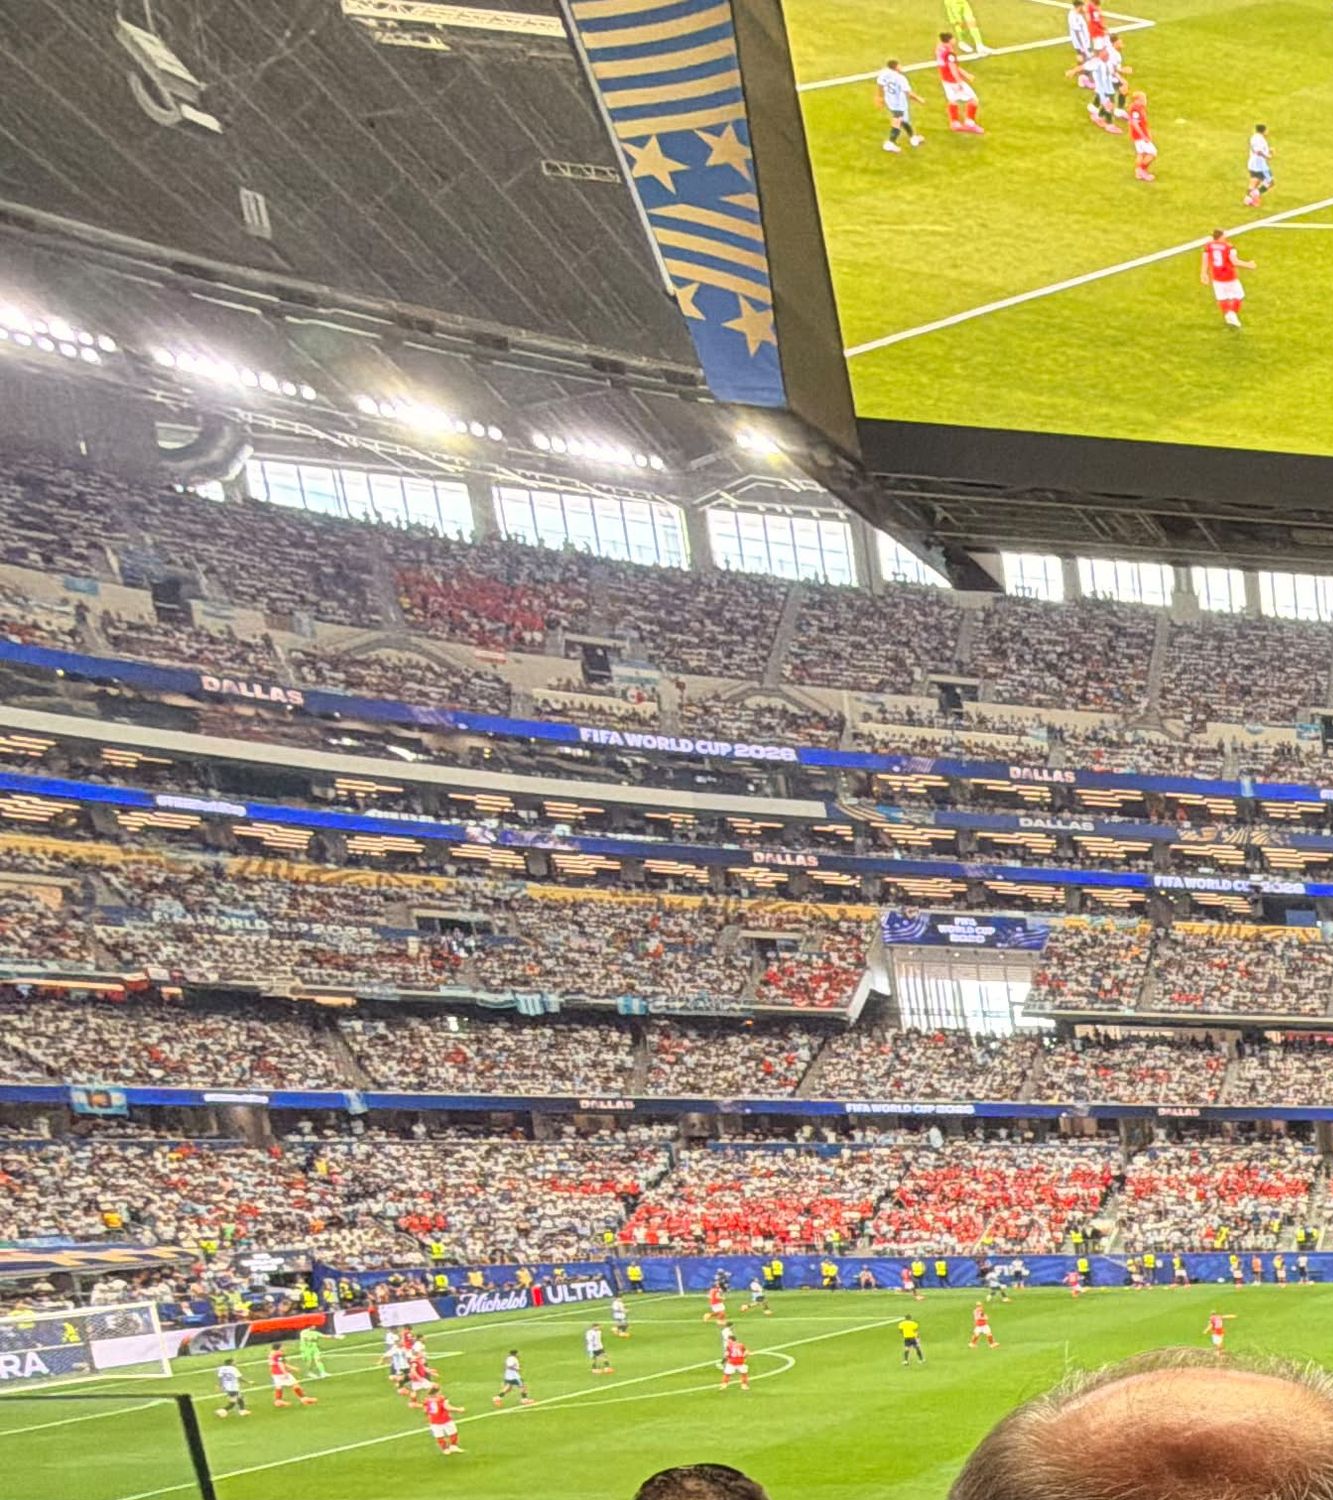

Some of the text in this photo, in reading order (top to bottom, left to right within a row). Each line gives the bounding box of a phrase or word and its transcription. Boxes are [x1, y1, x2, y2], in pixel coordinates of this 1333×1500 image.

[201, 675, 304, 704] DALLAS
[579, 727, 624, 747] FIFA
[624, 732, 694, 753] WORLD
[696, 740, 732, 757] CUP
[1009, 766, 1076, 783] DALLAS
[1019, 817, 1095, 832] DALLAS
[753, 851, 818, 866] DALLAS
[1154, 875, 1184, 888] FIFA
[1184, 877, 1231, 890] WORLD
[1232, 880, 1259, 892] CU
[579, 1100, 635, 1110] DALLAS
[456, 1280, 613, 1317] Michelob ULTRA
